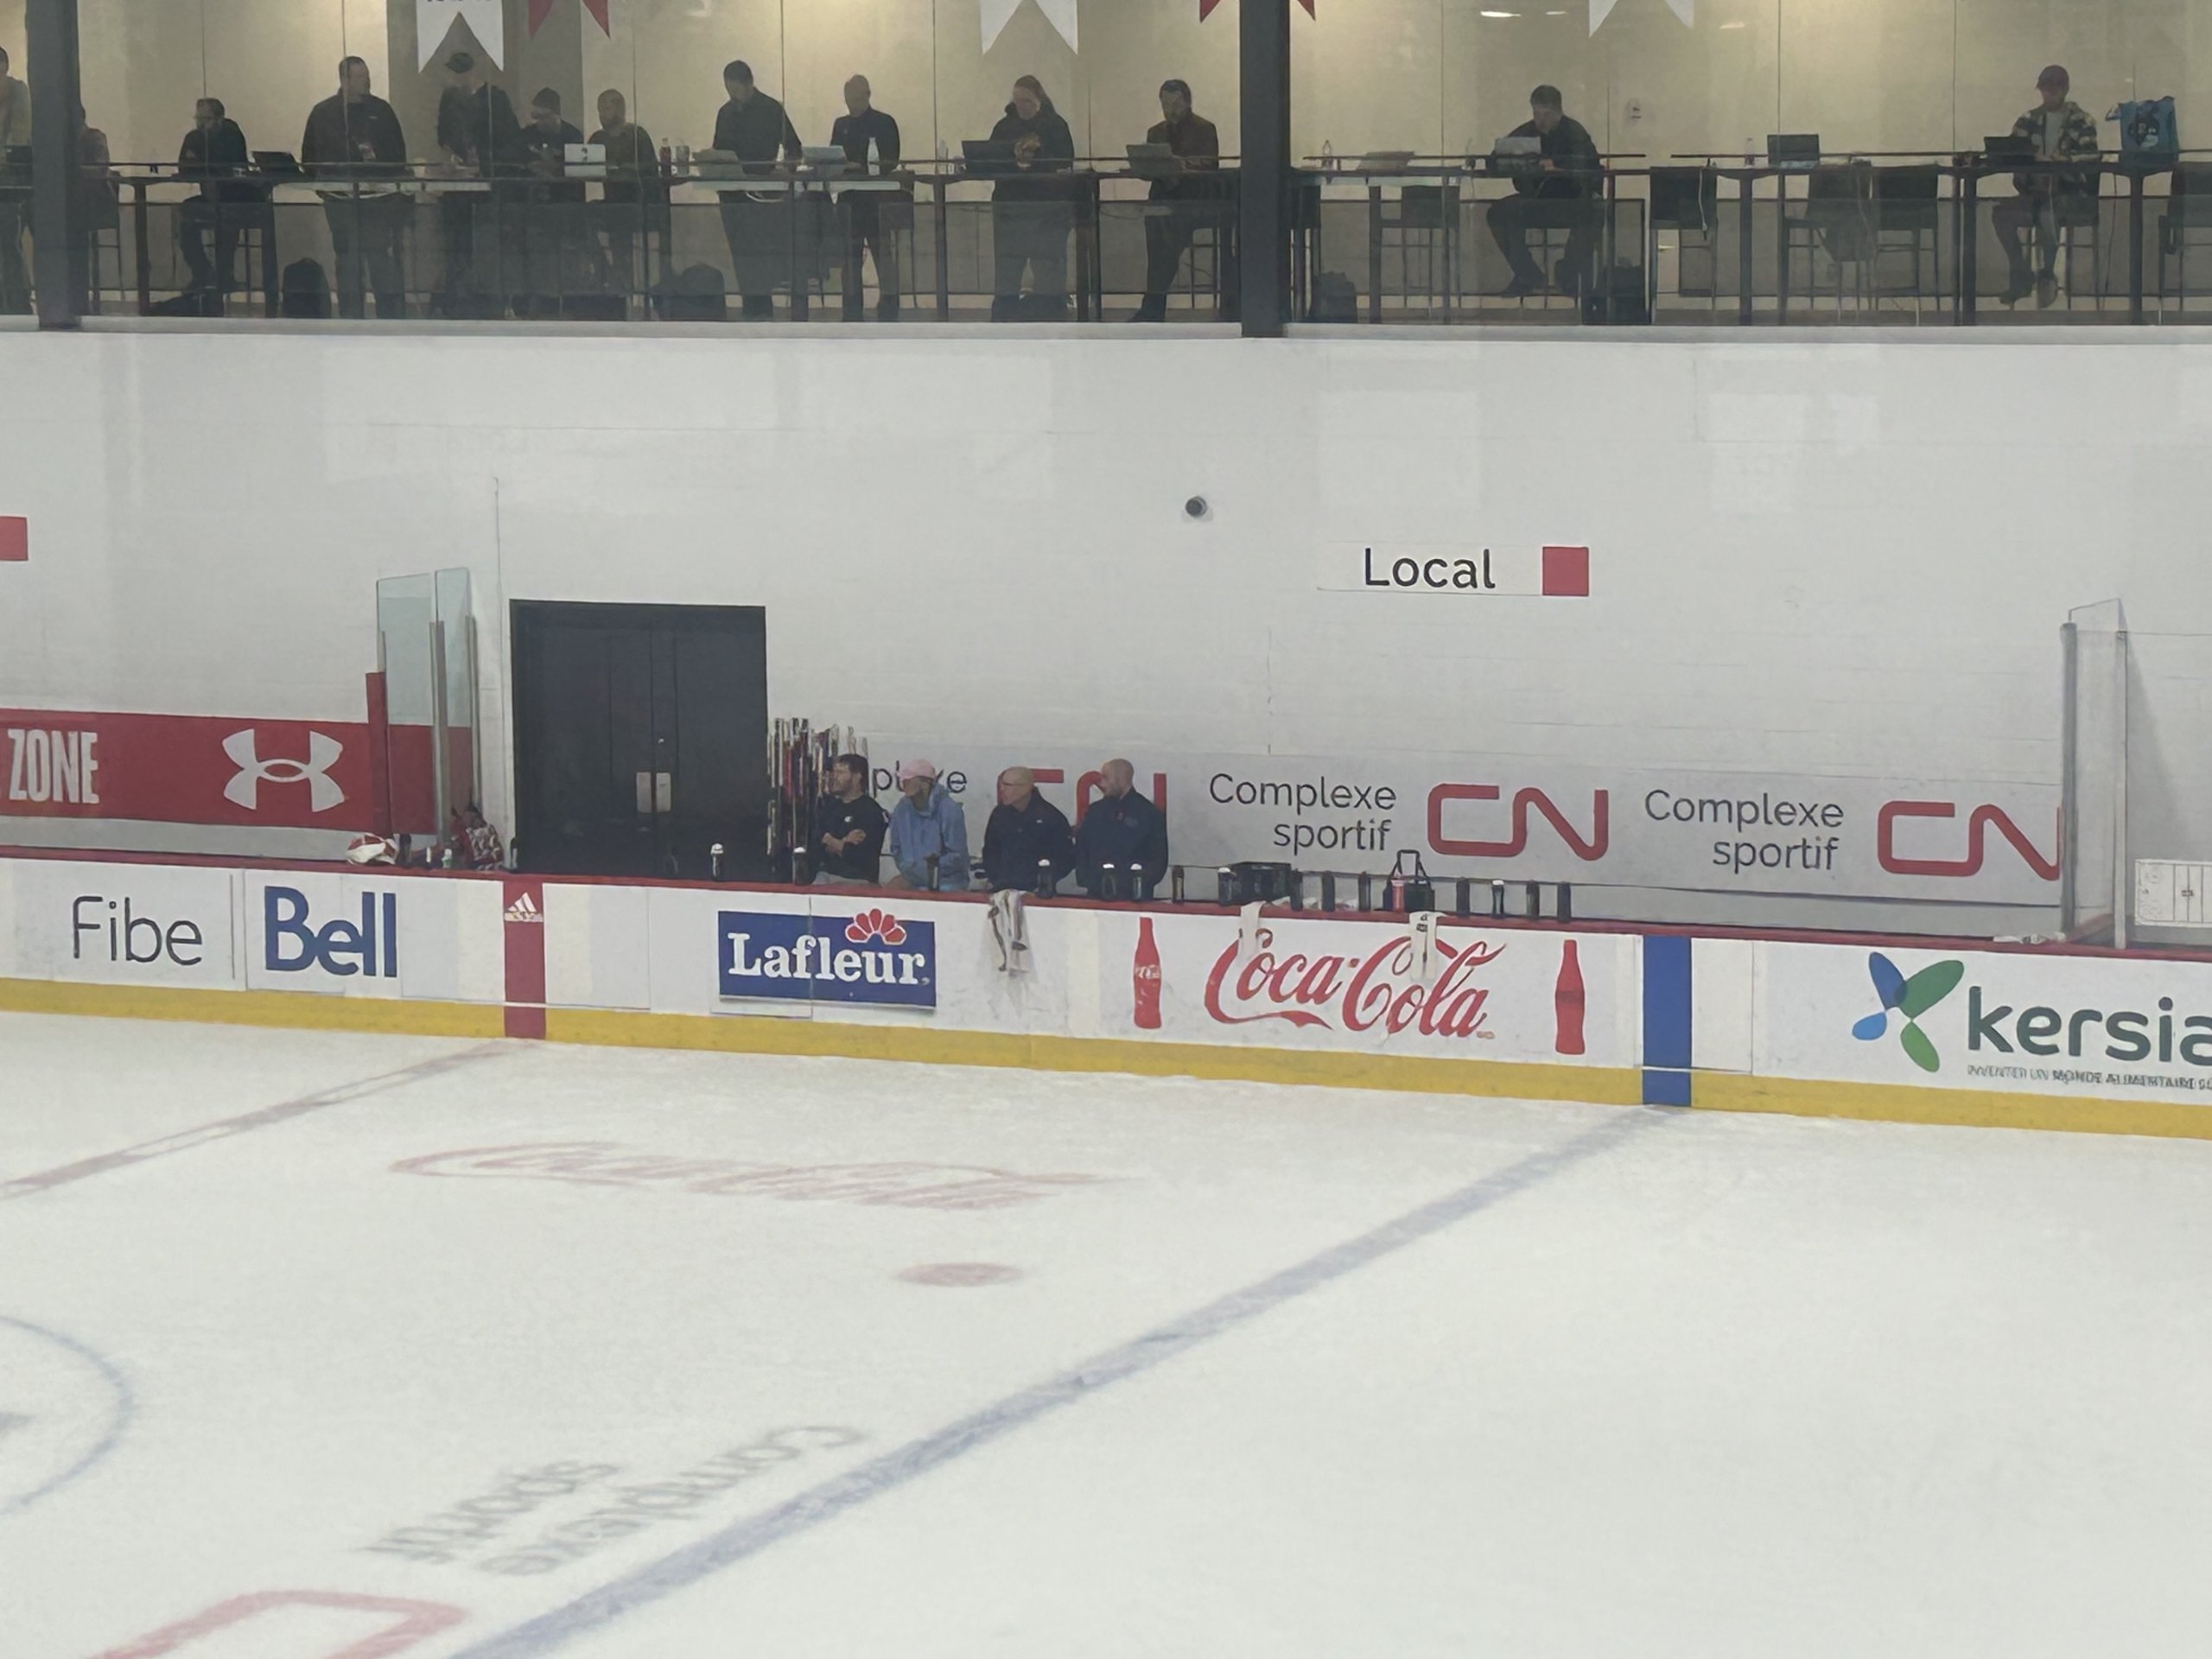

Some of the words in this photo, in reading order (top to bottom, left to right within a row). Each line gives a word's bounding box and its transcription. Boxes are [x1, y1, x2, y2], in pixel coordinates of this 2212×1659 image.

[1364, 547, 1496, 589] Local
[7, 728, 100, 804] ZONE
[1209, 772, 1397, 816] Complexe
[1273, 817, 1393, 855] sportif
[1427, 783, 1610, 861] CN
[1643, 789, 1845, 832] Complexe
[1878, 800, 2062, 881] CN
[1713, 836, 1840, 874] sportif
[73, 895, 203, 966] Fibe
[264, 885, 397, 978] Bell
[728, 932, 926, 986] Lafleur
[1967, 985, 2212, 1066] kersia
